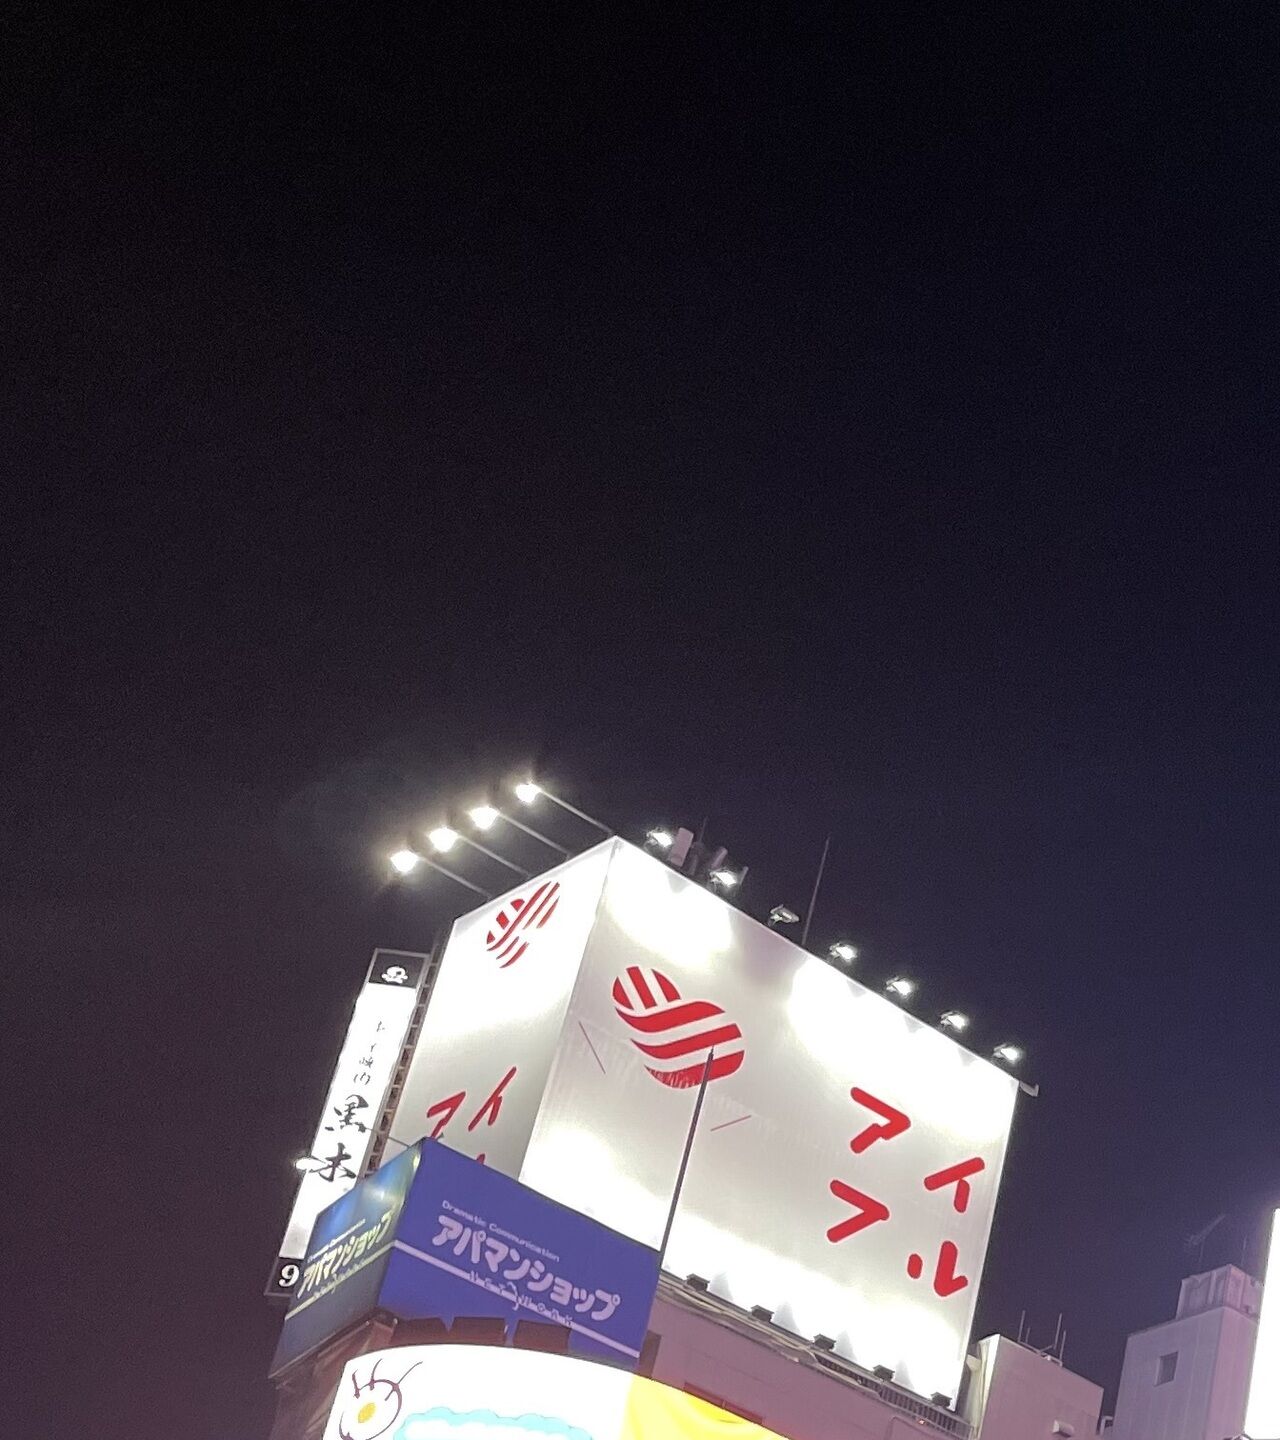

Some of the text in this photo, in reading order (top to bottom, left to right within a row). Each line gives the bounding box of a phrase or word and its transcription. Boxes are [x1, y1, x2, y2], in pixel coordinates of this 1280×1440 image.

[432, 1214, 621, 1321] アパマンショップ
